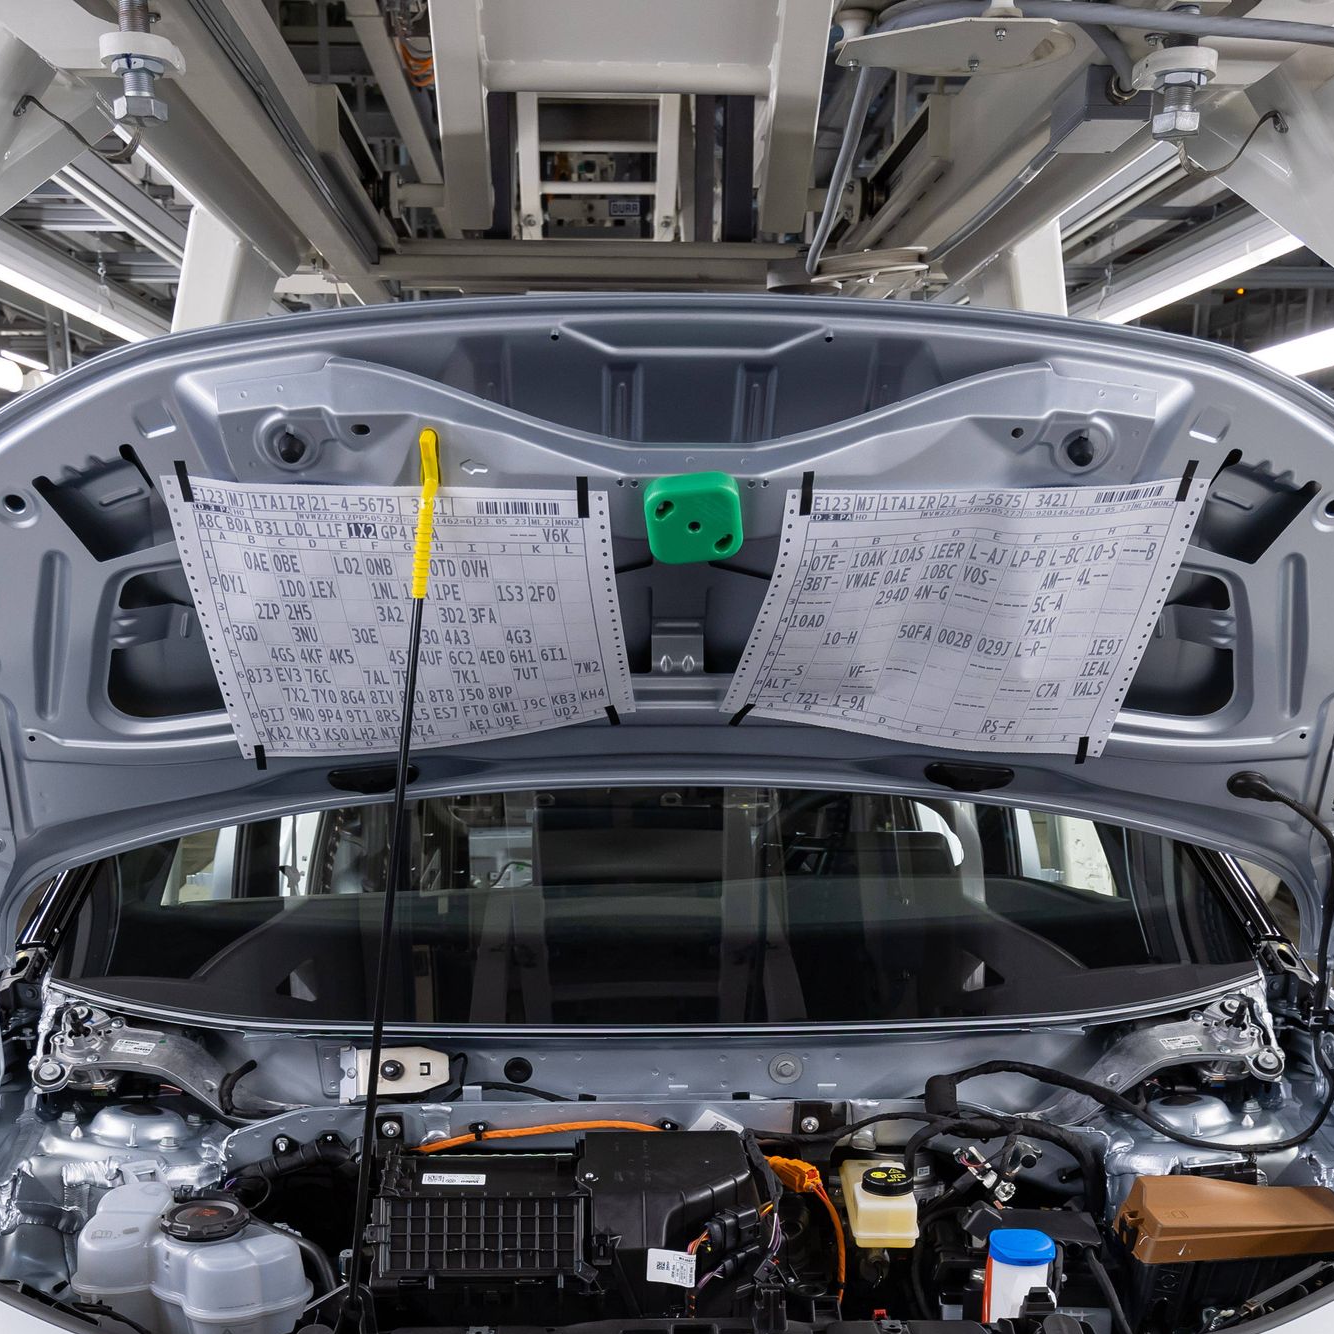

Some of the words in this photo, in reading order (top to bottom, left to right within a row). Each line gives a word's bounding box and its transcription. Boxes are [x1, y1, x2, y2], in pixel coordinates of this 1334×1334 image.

[192, 488, 225, 504] E123
[228, 491, 245, 507] MJ
[251, 494, 306, 510] 1TA1ZR
[311, 497, 395, 513] 21-4-5675
[813, 497, 850, 512] E123
[856, 497, 874, 511] MJ
[880, 496, 934, 511] 1TA1ZR
[940, 493, 1022, 508] 21-4-5675
[1036, 494, 1068, 507] 3421
[198, 515, 220, 529] A8C
[255, 520, 278, 535] B31
[317, 523, 342, 538] L1F
[349, 524, 377, 538] 1X2
[381, 525, 407, 539] GP4
[542, 529, 570, 543] V6K
[929, 542, 965, 559] 1EER
[969, 544, 1008, 565] L-AJ
[1010, 550, 1046, 567] LP-B
[1050, 546, 1084, 565] L-BC
[309, 581, 337, 598] 1EX
[371, 583, 398, 600] 1NL
[435, 584, 461, 600] 1PE
[496, 586, 524, 601] 1S3
[803, 577, 838, 591] 3BT-
[846, 572, 879, 589] VWAE
[875, 587, 909, 605] 294D
[914, 586, 949, 600] 4N-G
[1032, 593, 1064, 613] 5C-A
[257, 603, 280, 620] 2ZP
[285, 605, 312, 620] 2H5
[379, 606, 404, 622] 3A2
[440, 608, 466, 623] 3D2
[470, 608, 496, 624] 3FA
[234, 625, 258, 641] 3GD
[293, 627, 318, 642] 3NU
[354, 628, 379, 644] 3QE
[445, 630, 470, 644] 4A3
[506, 630, 532, 644] 4G3
[1024, 617, 1057, 636] 741K
[271, 648, 295, 662] 4GS
[300, 649, 323, 663] 4KF
[329, 649, 354, 664] 4K5
[419, 650, 443, 665] 4UF
[449, 651, 475, 665] 6C2
[510, 649, 536, 663] 6H1
[541, 648, 567, 661] 6I1
[1088, 639, 1123, 656] 1E9J
[247, 668, 273, 683] 8J3
[276, 669, 302, 682] EV3
[305, 669, 331, 683] 76C
[363, 670, 389, 684] 7AL
[453, 670, 480, 684] 7K1
[513, 667, 538, 680] 7UT
[575, 662, 600, 674] 7W2
[1079, 661, 1109, 676] 1EAL
[283, 688, 309, 702] 7X2
[341, 690, 366, 704] 8G4
[370, 690, 394, 704] 8IV
[430, 689, 454, 702] 8T8
[489, 686, 512, 699] 8VP
[1036, 683, 1060, 698] C7A
[1073, 681, 1104, 696] VALS
[261, 707, 284, 722] 9IJ
[318, 709, 342, 723] 9P4
[347, 710, 370, 723] 9T1
[376, 710, 400, 722] 8RS
[434, 707, 458, 720] ES7
[493, 702, 518, 714] GM1
[523, 698, 547, 711] J9C
[551, 694, 576, 705] KB3
[580, 688, 605, 700] KH4
[833, 694, 866, 710] 1-9A
[981, 719, 1015, 734] RS-F
[268, 727, 293, 741] KA2
[296, 728, 321, 741] KK3
[352, 728, 377, 740] LH2
[469, 719, 491, 731] AE1
[497, 716, 521, 727] U9E
[554, 706, 579, 717] UD2
